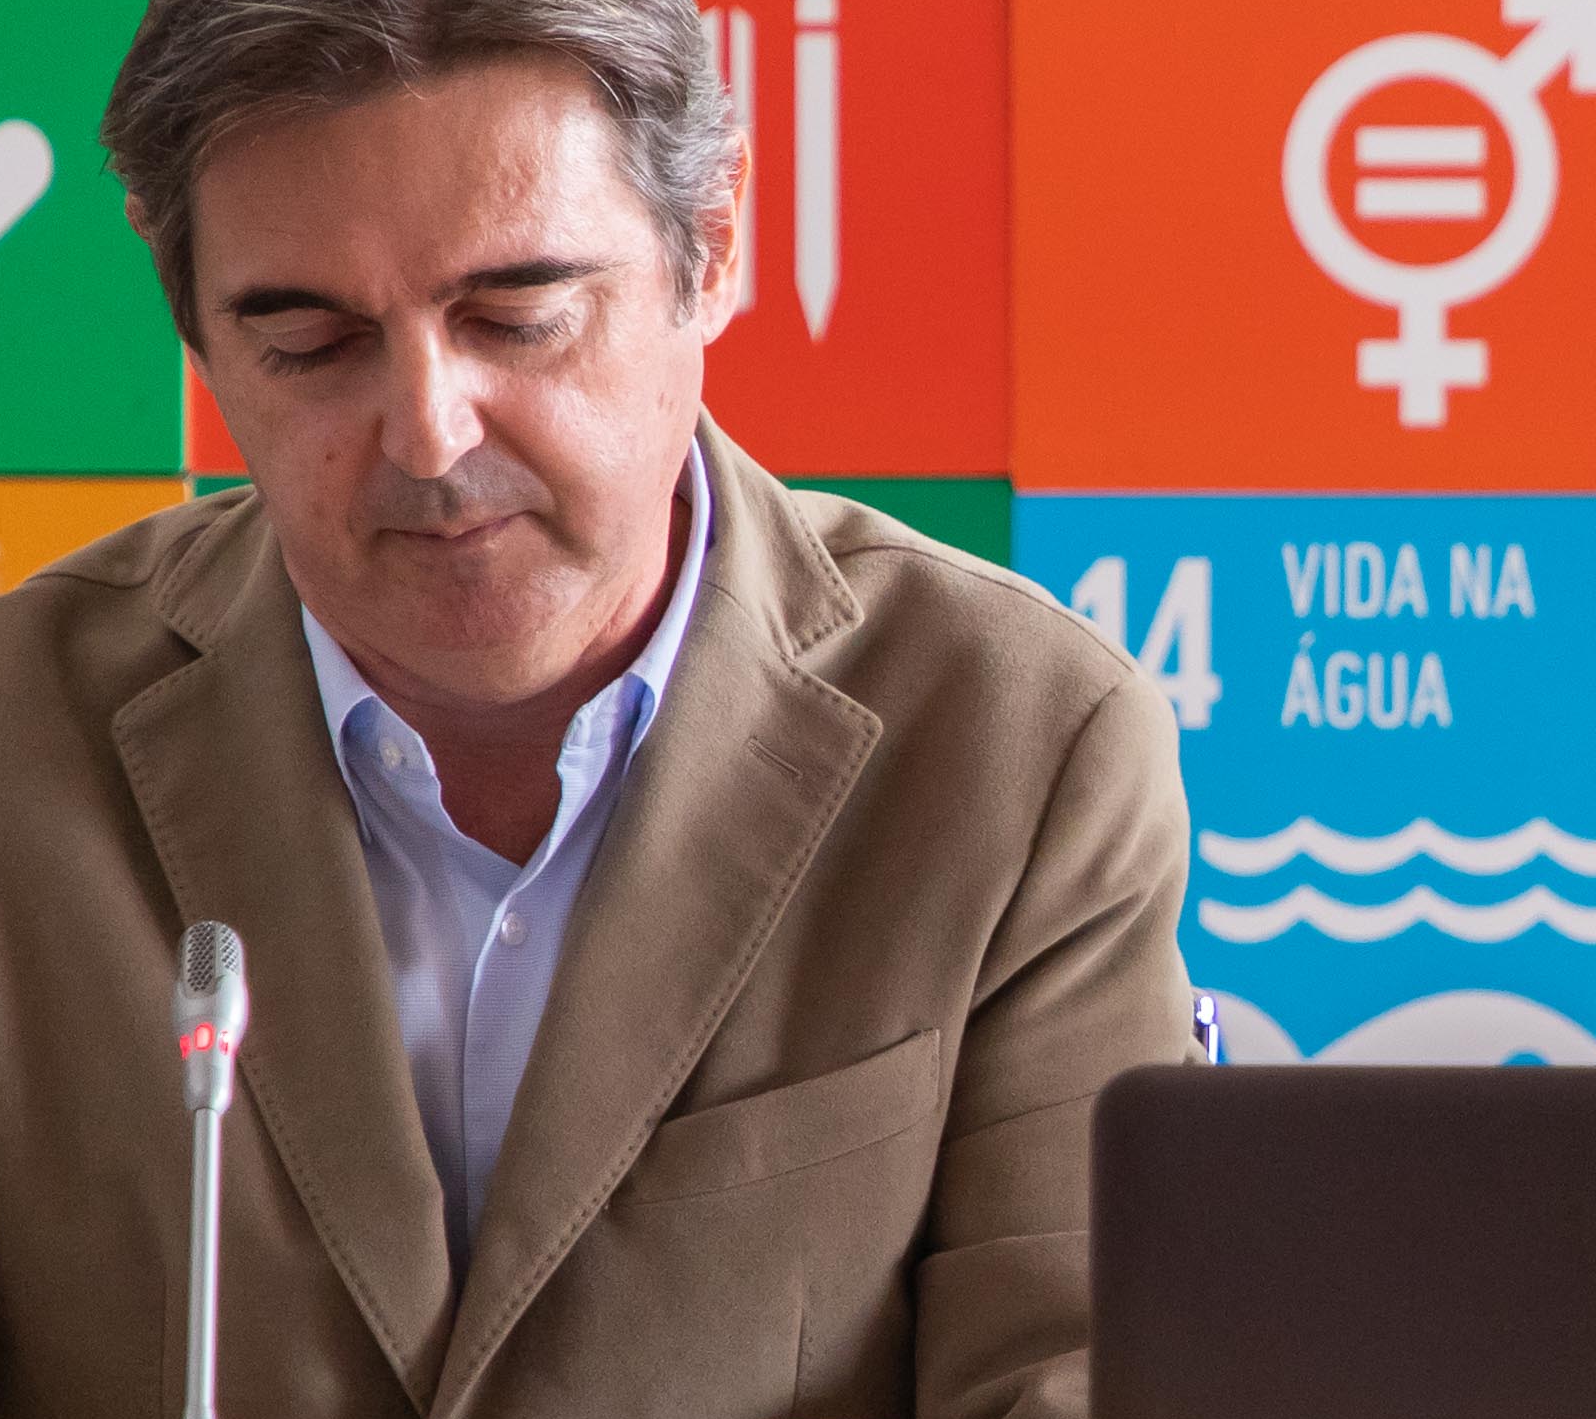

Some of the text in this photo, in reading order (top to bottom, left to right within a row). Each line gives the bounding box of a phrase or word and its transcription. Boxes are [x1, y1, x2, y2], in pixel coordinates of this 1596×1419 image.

[1282, 542, 1535, 619] VIDA NA
[1070, 555, 1223, 730] 14
[1281, 632, 1452, 729] ÁGUA
